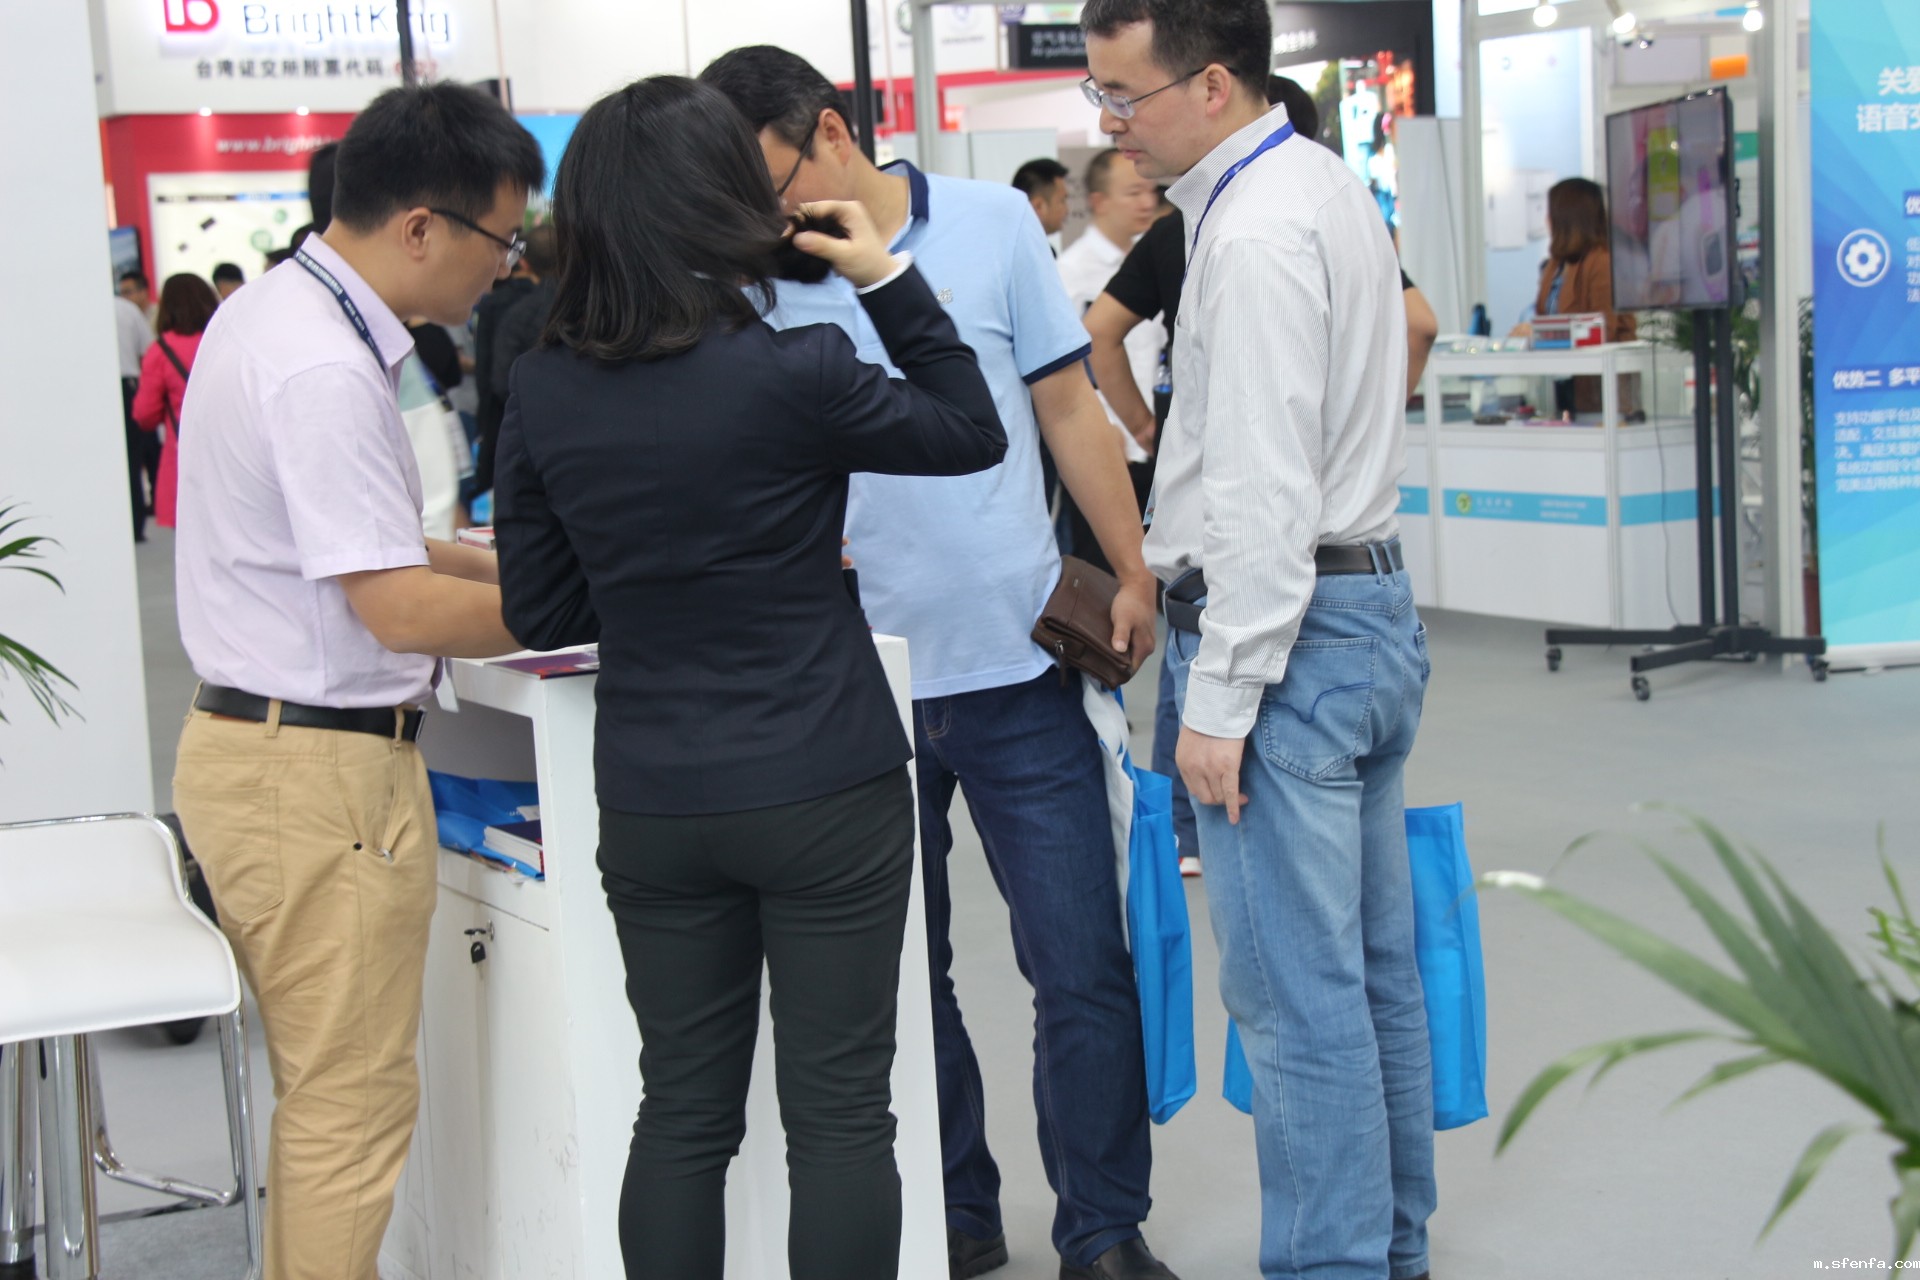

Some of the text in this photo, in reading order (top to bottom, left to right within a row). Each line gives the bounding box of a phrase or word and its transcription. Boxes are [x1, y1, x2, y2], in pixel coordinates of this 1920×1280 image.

[243, 5, 449, 43] BrightKng
[1833, 369, 1882, 389] 优势二
